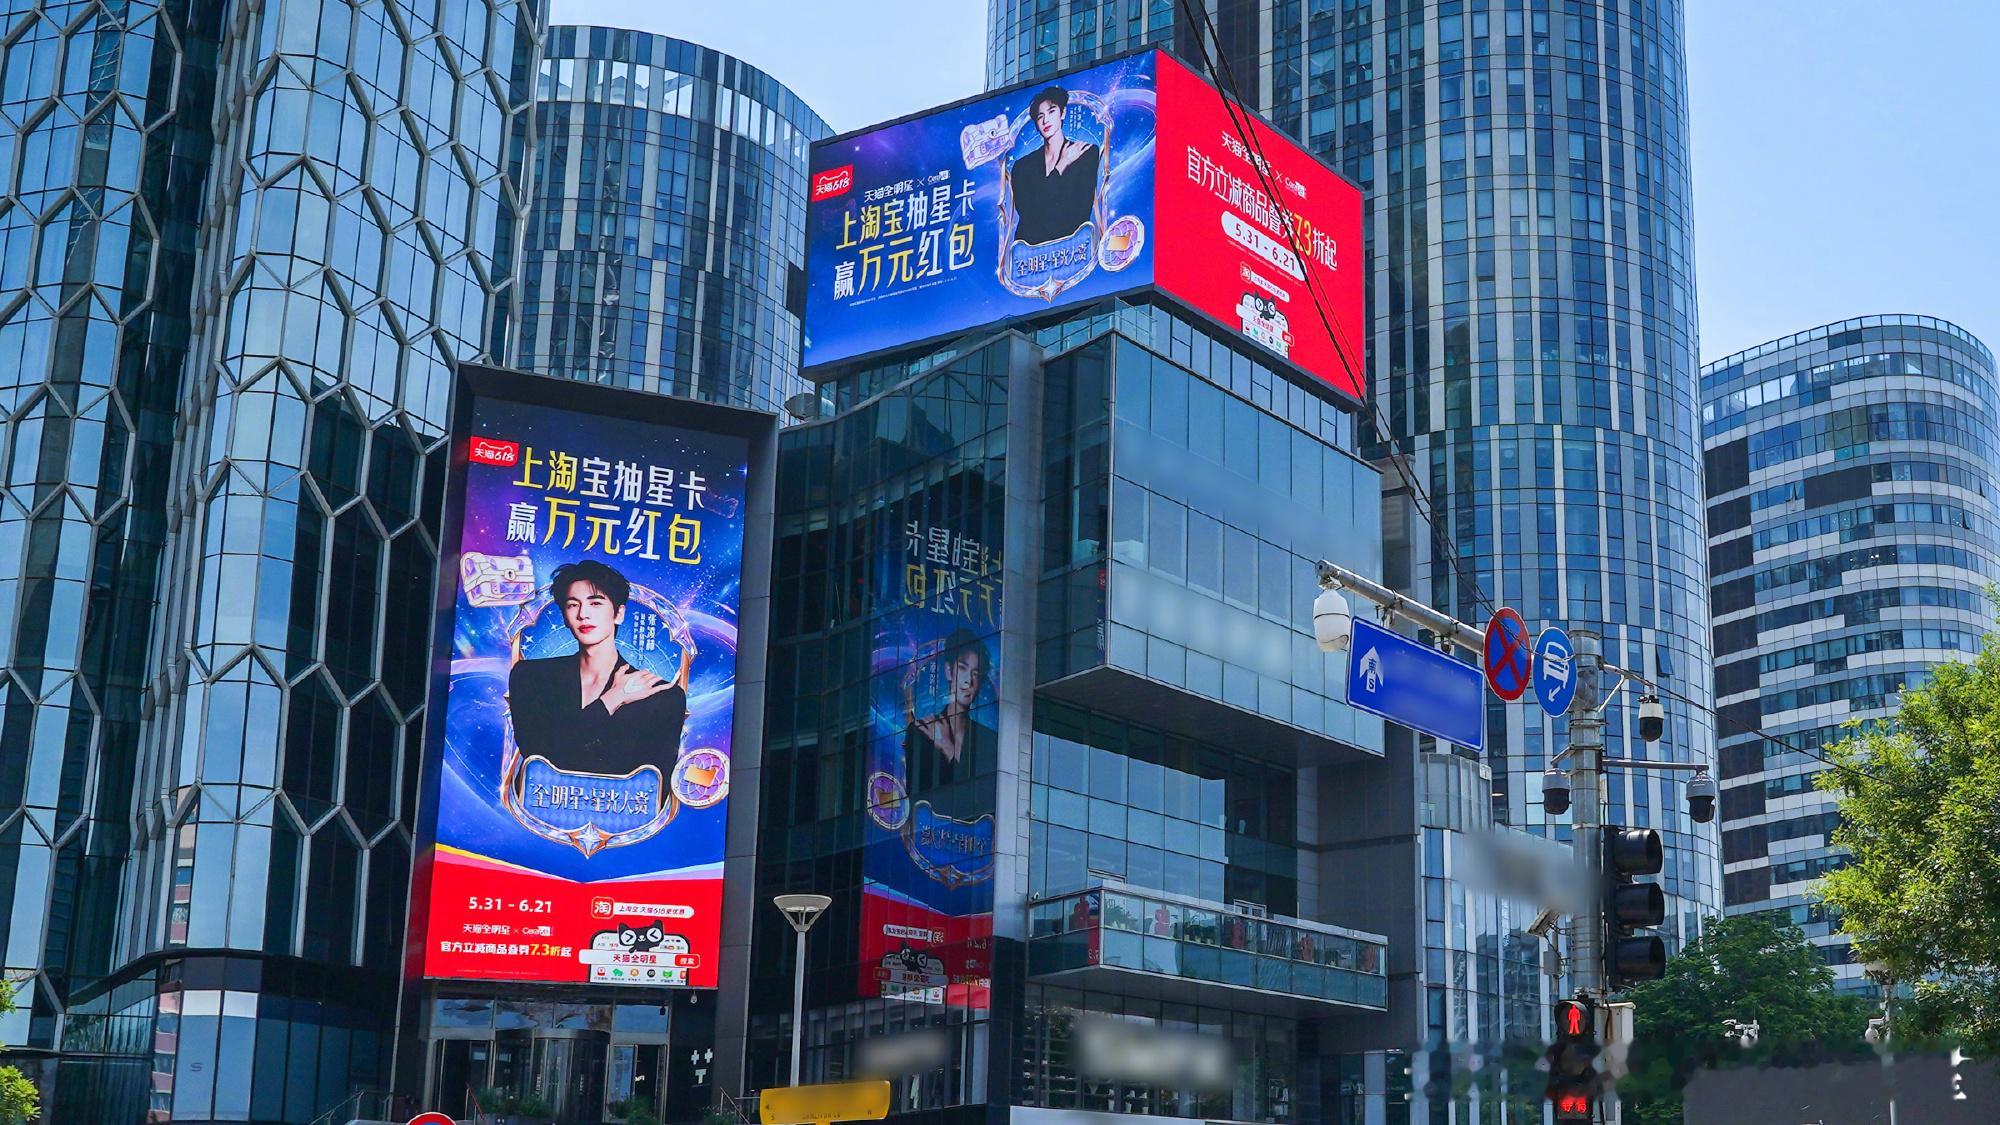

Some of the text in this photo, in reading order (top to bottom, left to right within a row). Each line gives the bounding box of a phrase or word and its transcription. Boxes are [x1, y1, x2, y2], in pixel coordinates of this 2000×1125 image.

[816, 177, 850, 196] 天猫618
[864, 179, 914, 203] 天猫全明星
[836, 179, 976, 251] 上淘宝抽星卡
[1235, 223, 1259, 248] 5.31
[1272, 247, 1295, 271] 6.21
[833, 223, 975, 301] 赢万元红包
[474, 447, 515, 462] 天猫618
[512, 446, 707, 512] 上淘宝抽星卡
[505, 495, 704, 565] 赢万元红包
[1368, 678, 1375, 690] S
[468, 896, 502, 910] 5.31
[519, 899, 553, 914] 6.21
[594, 901, 611, 915] 淘
[463, 923, 511, 936] 天猫全明星
[440, 940, 572, 957] 官方立减商品叠券7.3折起
[613, 953, 657, 964] 天猫全明星
